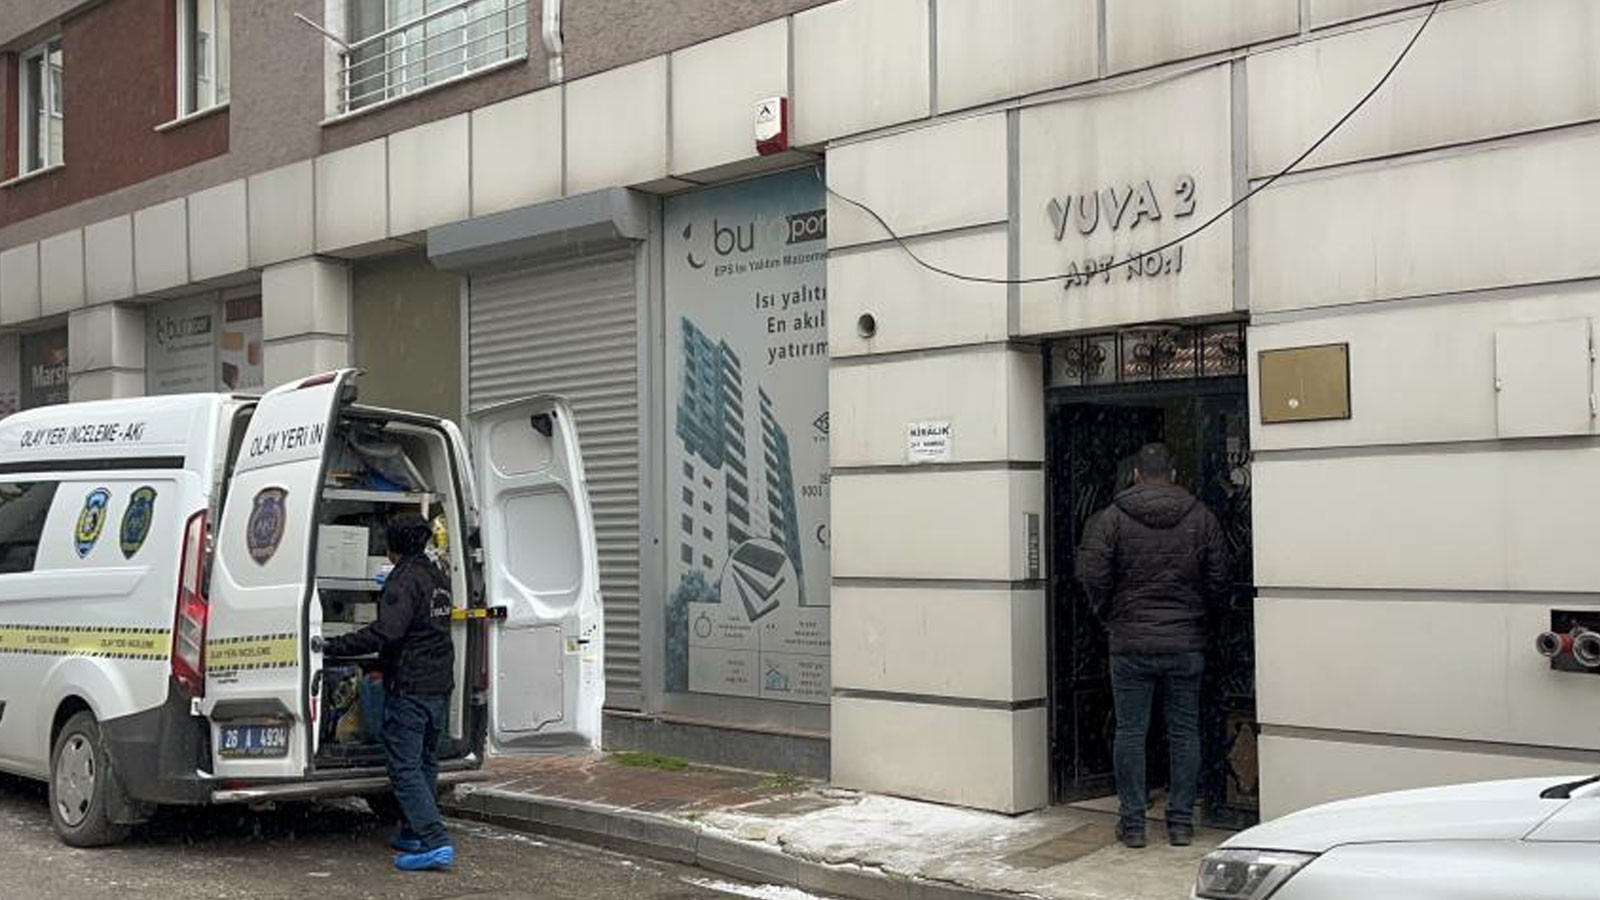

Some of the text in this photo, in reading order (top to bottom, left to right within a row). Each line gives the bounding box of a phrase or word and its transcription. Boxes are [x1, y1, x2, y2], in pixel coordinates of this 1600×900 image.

[1048, 174, 1197, 242] YUVA 2
[1063, 255, 1115, 291] APT
[767, 316, 787, 334] En
[250, 429, 280, 458] OLAY
[225, 729, 239, 749] 26
